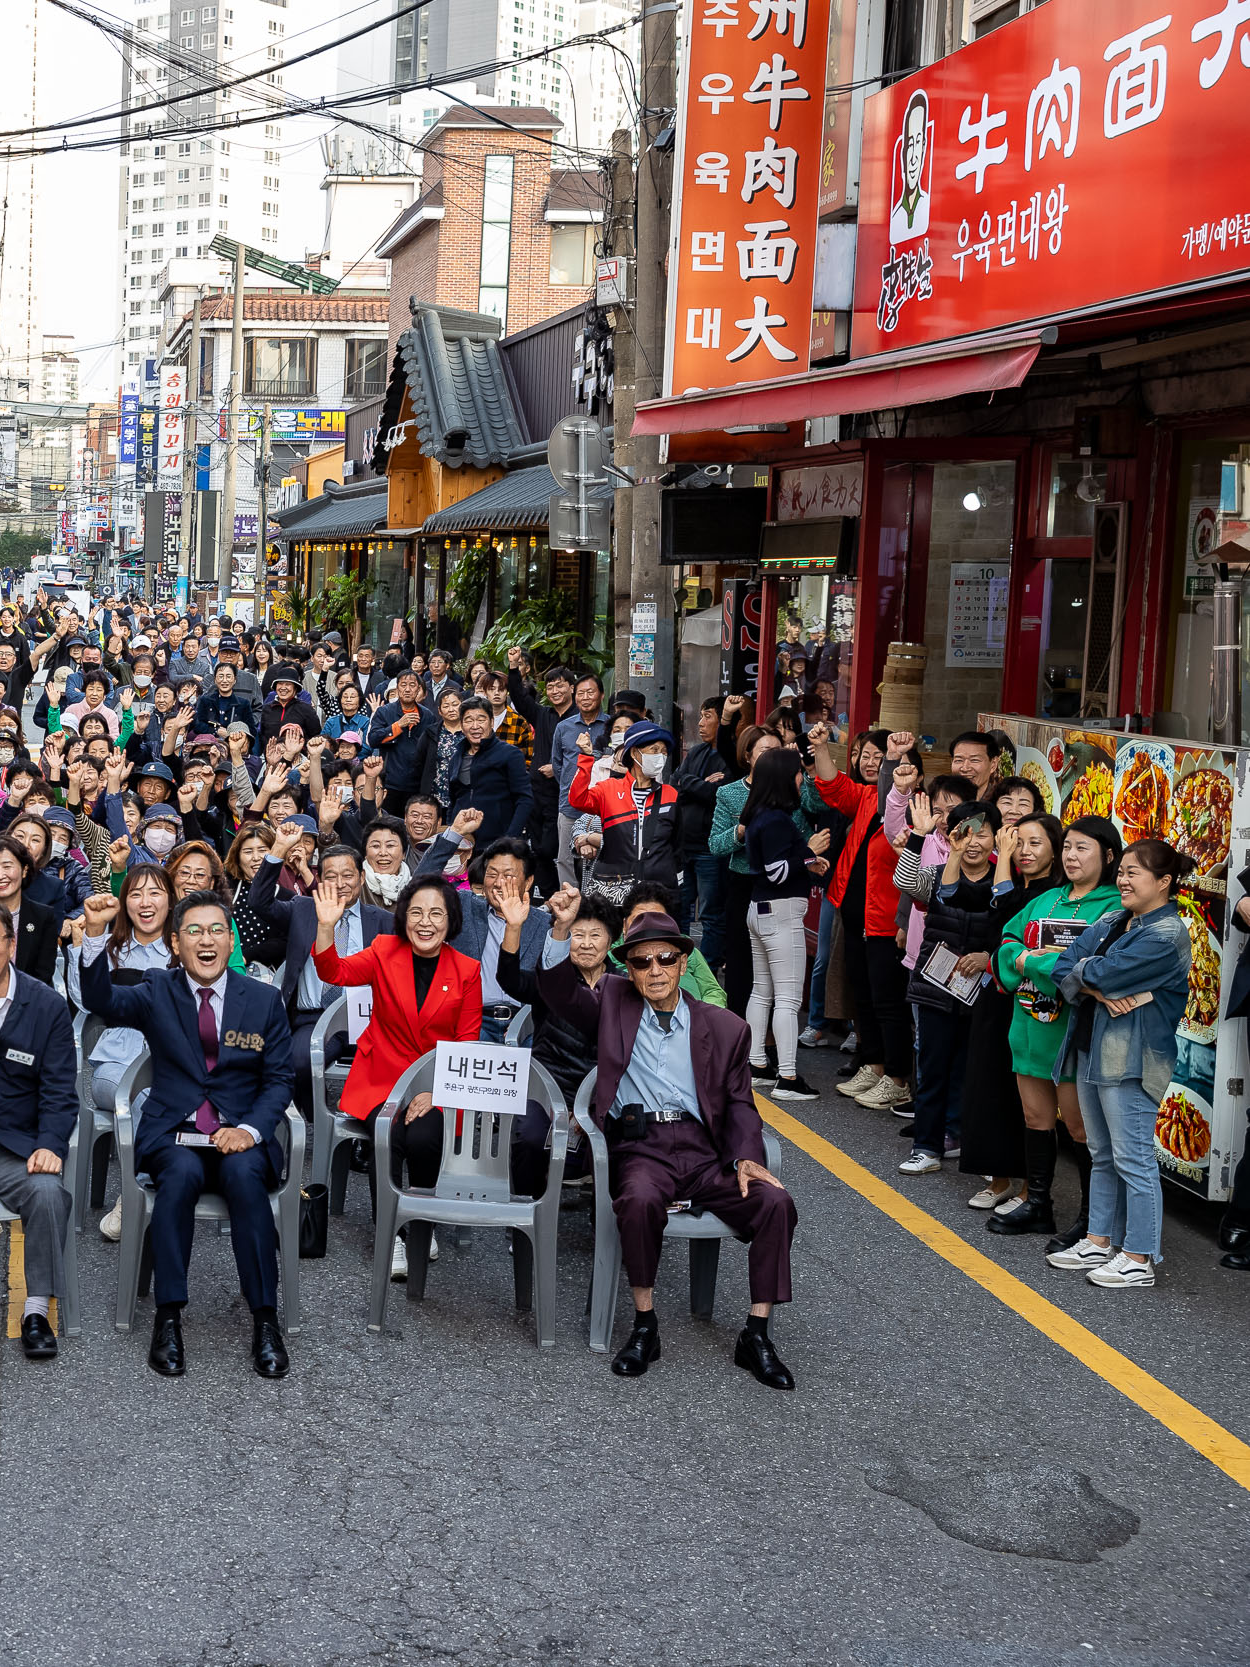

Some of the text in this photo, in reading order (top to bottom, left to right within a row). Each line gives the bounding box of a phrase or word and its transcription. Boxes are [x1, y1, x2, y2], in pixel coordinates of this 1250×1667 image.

[682, 0, 740, 394] 주우육면대
[726, 0, 811, 434] 州牛肉面大
[952, 183, 1070, 283] 우육면대왕
[162, 372, 181, 469] 송화양꼬치
[980, 568, 994, 580] 10
[224, 1030, 265, 1052] 오신환
[447, 1055, 518, 1083] 내빈석
[503, 1088, 518, 1098] 의장
